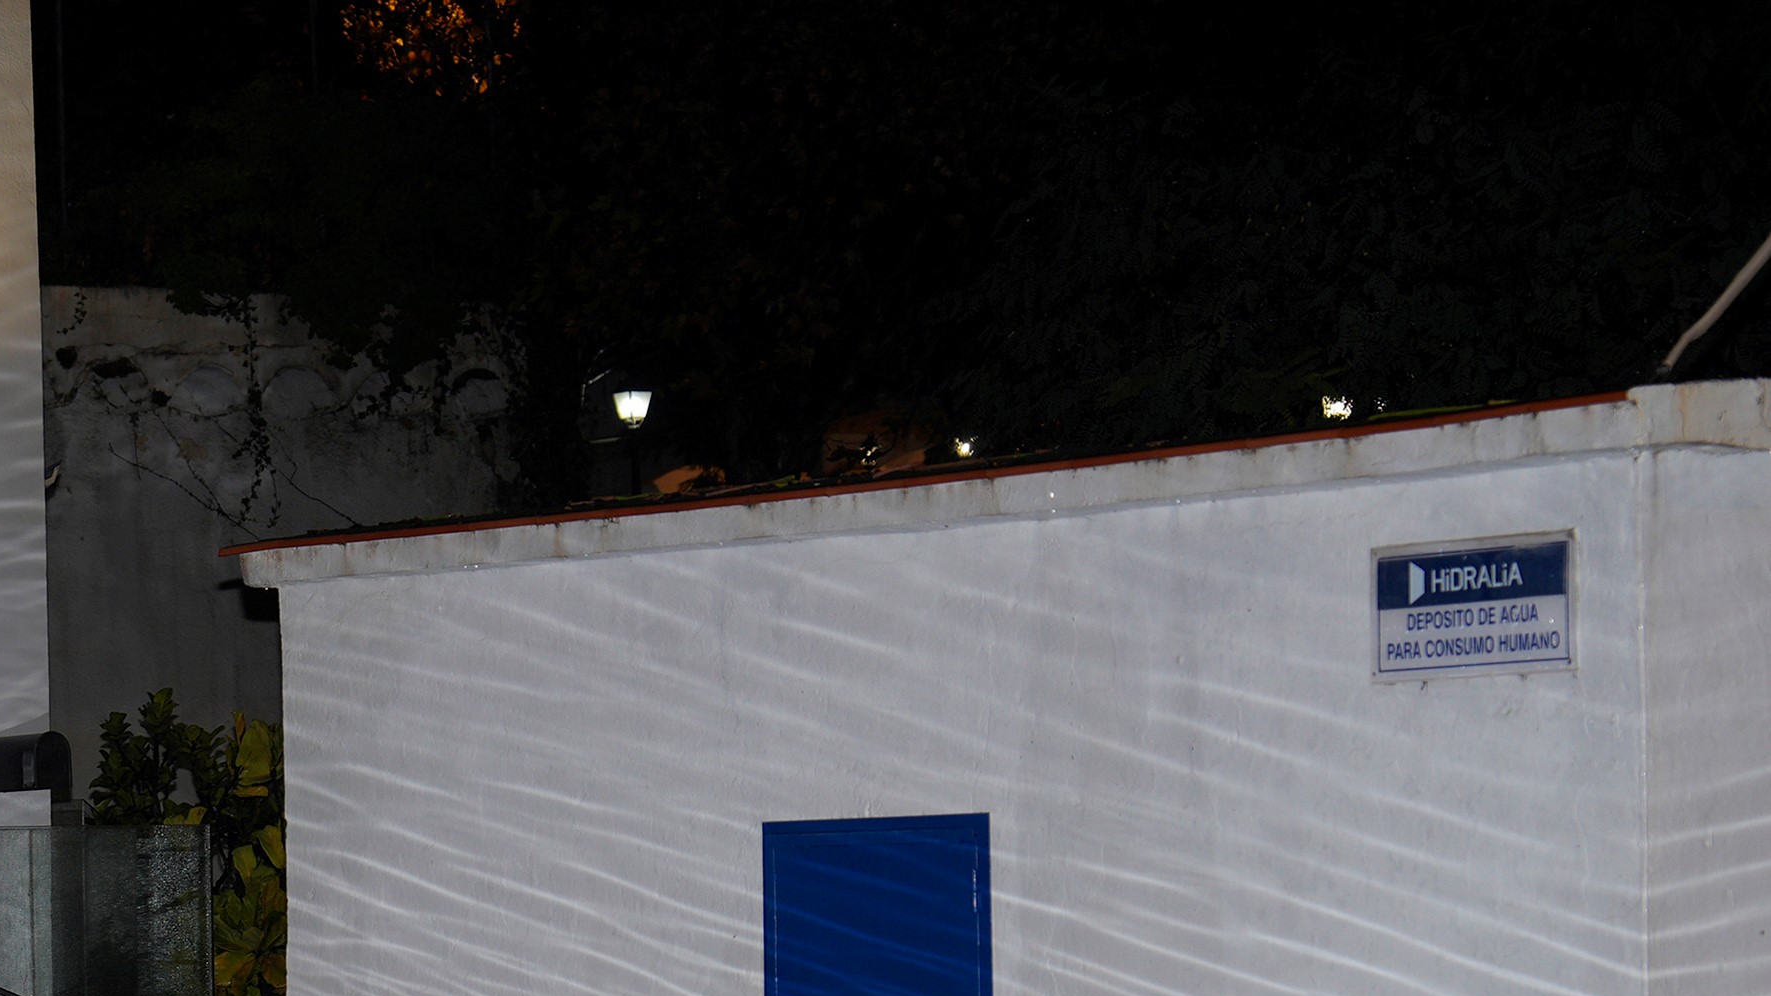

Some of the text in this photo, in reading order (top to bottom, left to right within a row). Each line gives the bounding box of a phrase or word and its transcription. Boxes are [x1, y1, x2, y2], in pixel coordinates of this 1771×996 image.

[1407, 604, 1538, 631] DEPOSITO DE AGUA
[1387, 631, 1560, 661] PARA CONSUMO HUMANO
